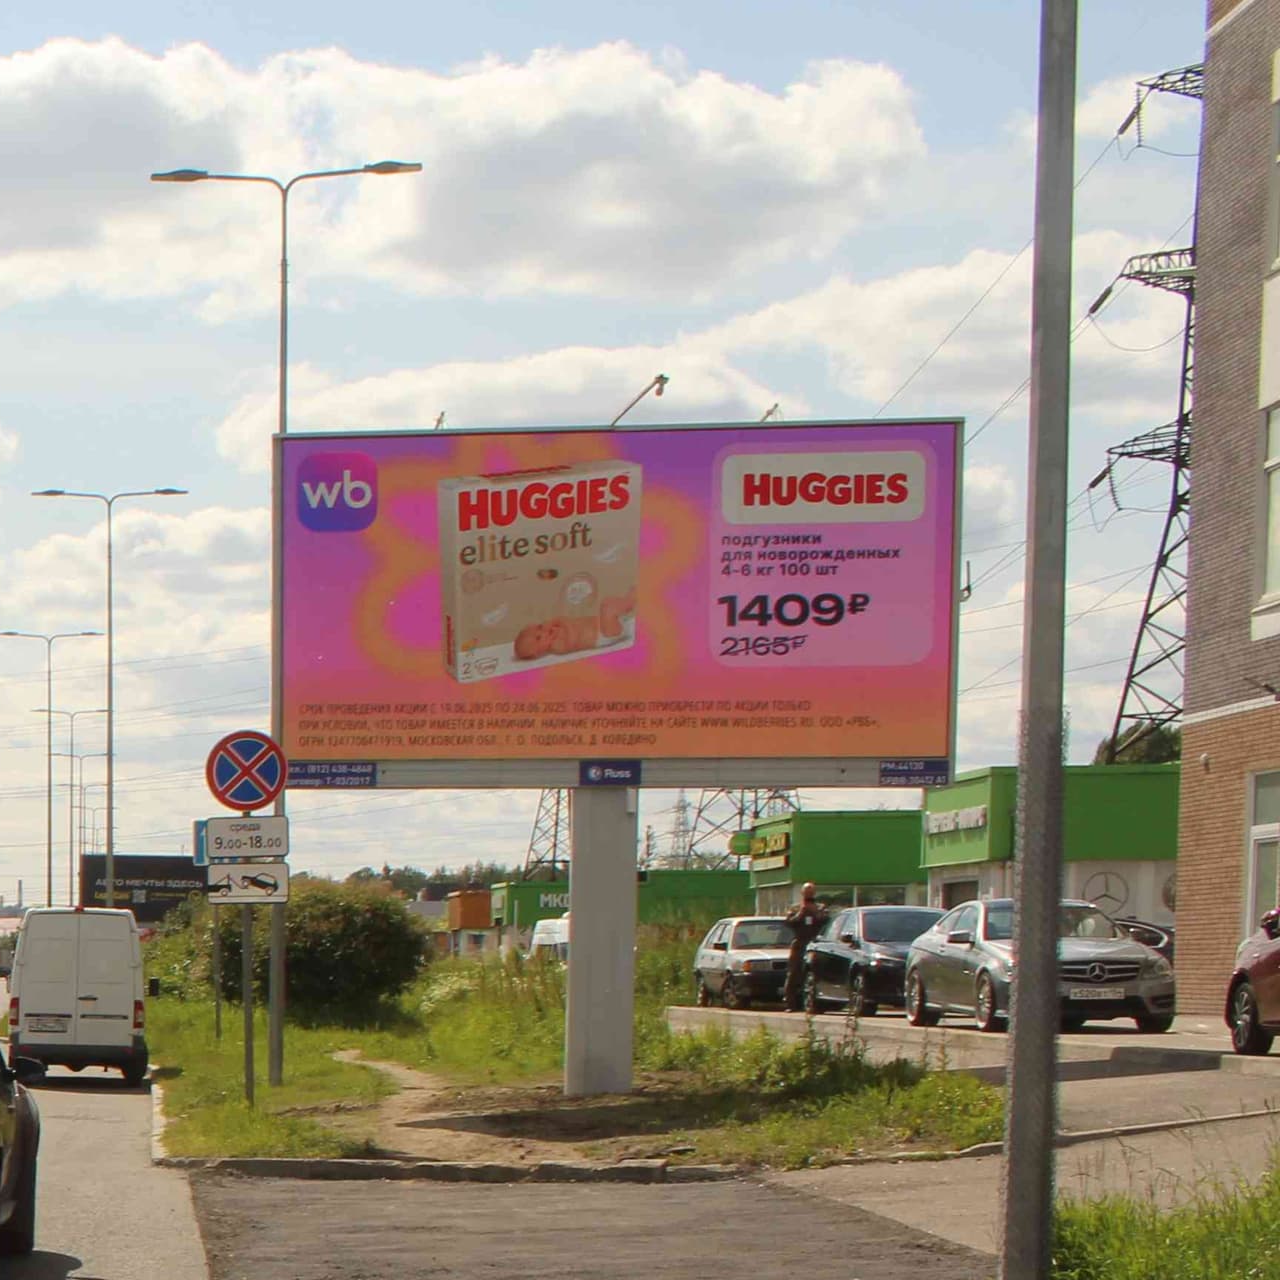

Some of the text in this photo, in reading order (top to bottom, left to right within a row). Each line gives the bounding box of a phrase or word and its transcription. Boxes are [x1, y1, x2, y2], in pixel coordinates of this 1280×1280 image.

[301, 469, 373, 509] wb
[743, 472, 908, 506] HUGGIES
[458, 475, 631, 532] HUGGIES
[458, 521, 593, 565] elite soft
[720, 534, 822, 548] подгузники
[720, 549, 901, 563] для новорожденных
[721, 564, 840, 577] 4-6 кг 100 шт
[604, 769, 632, 779] Russ
